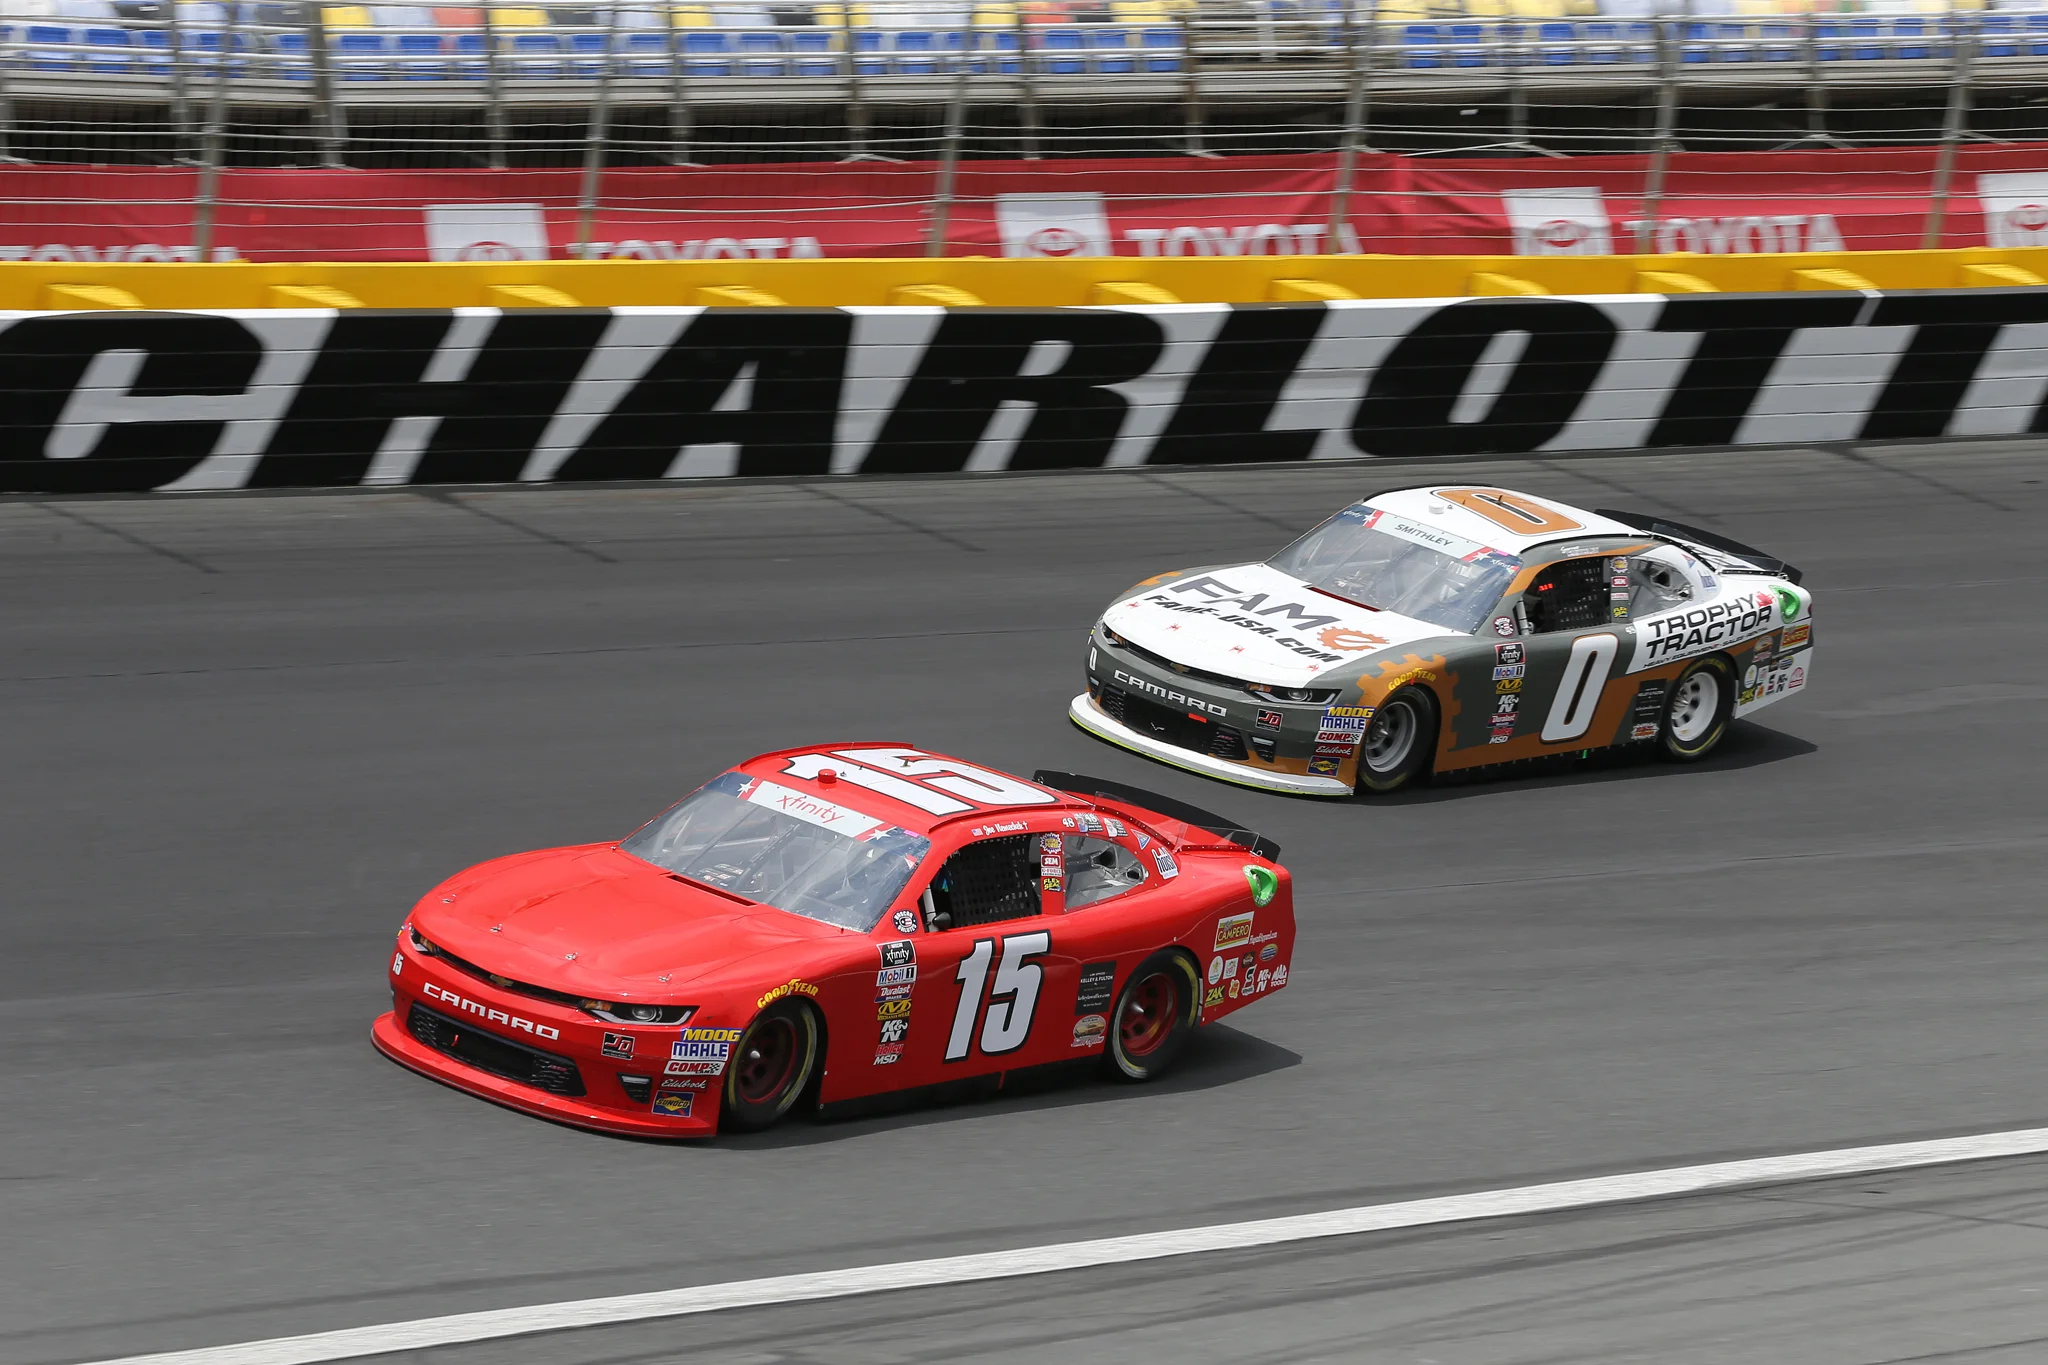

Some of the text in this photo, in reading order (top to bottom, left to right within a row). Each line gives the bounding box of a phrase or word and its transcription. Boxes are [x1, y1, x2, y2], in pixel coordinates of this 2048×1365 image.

[1620, 213, 1848, 254] TOYOTA
[0, 292, 2048, 492] CHARLOTT
[1430, 487, 1587, 537] 0
[1394, 523, 1454, 547] SMITHLEY
[1648, 593, 1754, 637] TROPHY
[1143, 594, 1345, 663] FAME-USA.COM
[1646, 605, 1772, 659] TRACTOR
[1495, 667, 1515, 677] Mobil
[1114, 669, 1228, 718] CAMARO
[1540, 632, 1619, 742] 0
[1327, 706, 1374, 718] MOOG
[1321, 717, 1366, 730] MAHLE
[1318, 732, 1351, 741] COMP
[1489, 735, 1509, 744] MSD
[1315, 745, 1352, 755] Edelbrock
[778, 748, 1058, 816] 15
[775, 794, 846, 824] xfinity
[1044, 857, 1059, 866] SEM
[1217, 924, 1250, 942] CAMPERO
[392, 952, 404, 976] 15
[886, 948, 910, 963] xfinity
[879, 969, 905, 984] Mobil
[757, 978, 819, 1009] GOODYEAR
[880, 984, 911, 997] Duralast
[943, 930, 1050, 1062] 15
[1205, 985, 1226, 1002] ZAK
[423, 981, 560, 1041] CAMARO
[682, 1028, 742, 1042] MOOG
[672, 1042, 729, 1057] MAHLE
[668, 1062, 711, 1073] COMP
[873, 1054, 899, 1066] MSD
[660, 1078, 706, 1089] Edelbrock
[656, 1098, 691, 1109] SUNOCO
